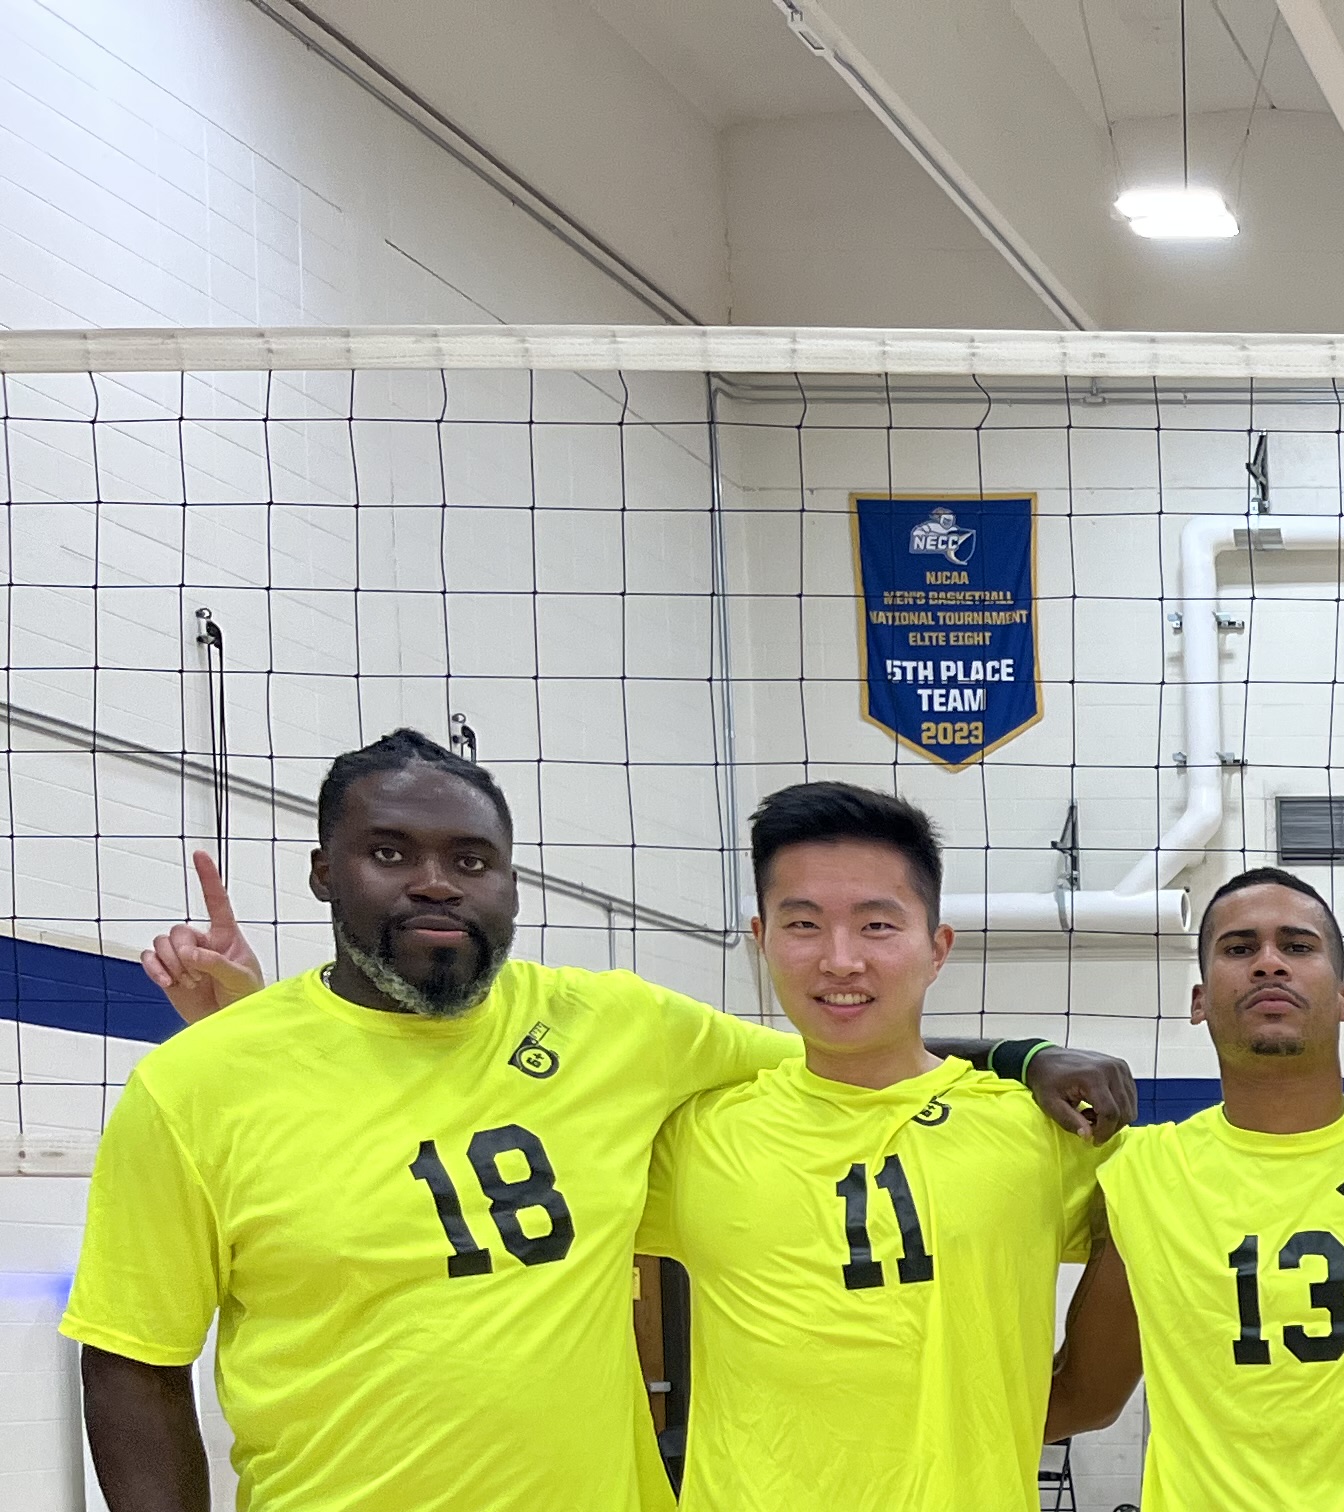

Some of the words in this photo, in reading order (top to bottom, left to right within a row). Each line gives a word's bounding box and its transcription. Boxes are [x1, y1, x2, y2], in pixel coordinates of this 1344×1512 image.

[913, 535, 960, 550] NECC
[926, 571, 969, 585] NJCAA
[869, 610, 935, 625] NATIONAL
[937, 609, 1029, 625] TOURNAMENT
[908, 632, 946, 646] ELITE
[950, 632, 992, 646] EIGHT
[886, 659, 934, 684] 5TH
[940, 659, 1015, 684] PLACE
[917, 688, 987, 712] TEAM
[921, 722, 984, 745] 2023
[409, 1124, 575, 1279] 18
[836, 1153, 934, 1290] 11
